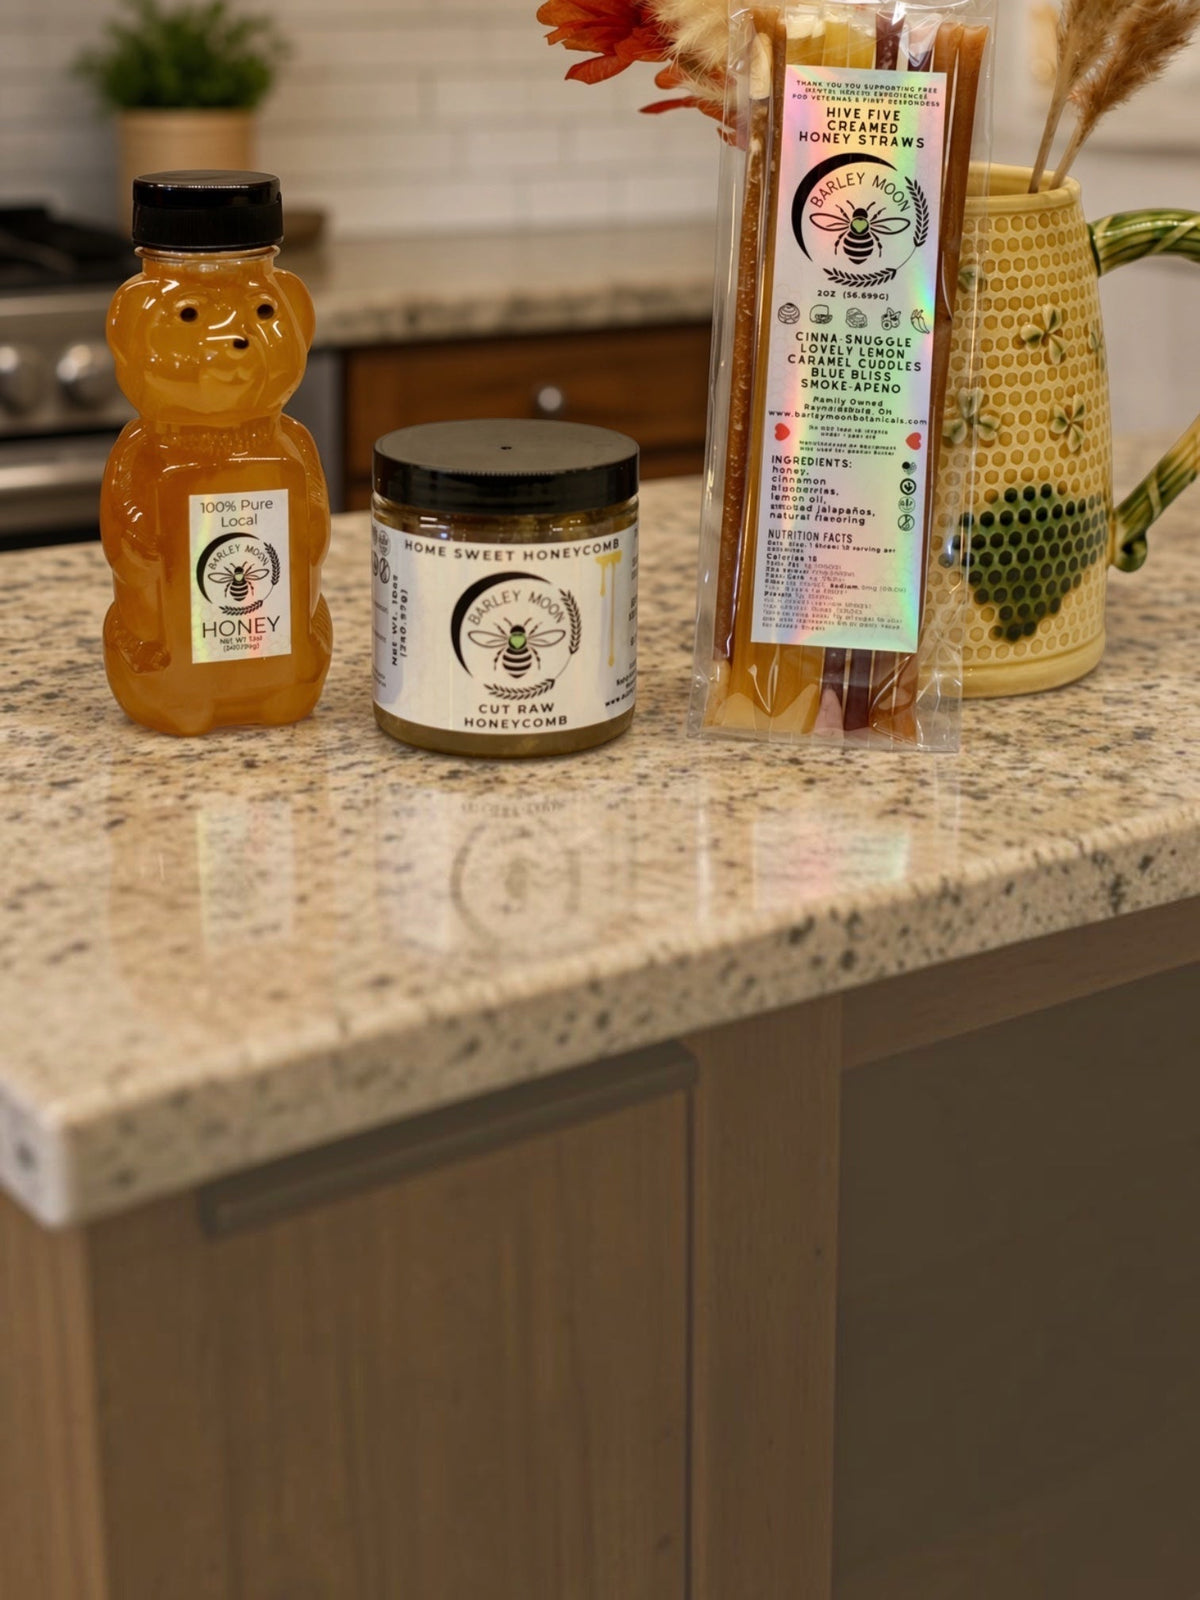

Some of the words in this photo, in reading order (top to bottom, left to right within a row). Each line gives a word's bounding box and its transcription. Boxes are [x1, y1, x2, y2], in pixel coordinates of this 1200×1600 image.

[827, 107, 861, 119] HIVE
[868, 109, 901, 122] FIVE
[827, 120, 899, 134] CREAMED
[799, 131, 851, 145] HONEY
[858, 134, 925, 149] STRAWS
[810, 172, 866, 208] BARLEY
[872, 174, 911, 213] MOON
[795, 331, 912, 348] CINNA-SNUGGLE
[800, 343, 854, 356] LOVELY
[859, 348, 905, 359] LEMON
[787, 354, 852, 368] CARAMEL
[858, 358, 922, 372] CUDDLES
[811, 367, 845, 379] BLUE
[851, 369, 892, 382] BLISS
[801, 378, 902, 394] SMOKE-APENO
[849, 398, 884, 407] Owned
[771, 455, 852, 469] INGREDIENTS:
[771, 475, 827, 485] cinnamon
[771, 492, 805, 502] lemon
[200, 500, 237, 514] 100%
[240, 499, 273, 511] Pure
[221, 513, 258, 527] Local
[768, 529, 819, 541] NUTRITION
[823, 532, 853, 544] FACTS
[208, 543, 241, 570] BARLEY
[244, 544, 269, 567] MOON
[405, 540, 447, 557] HOME
[454, 548, 514, 561] SWEET
[523, 538, 620, 561] HONEYCOMB
[467, 589, 521, 626] BARLEY
[528, 590, 566, 624] MOON
[202, 615, 280, 639] HONEY
[478, 704, 510, 714] CUT
[518, 702, 555, 714] RAW
[464, 716, 568, 729] HONEYCOMB
